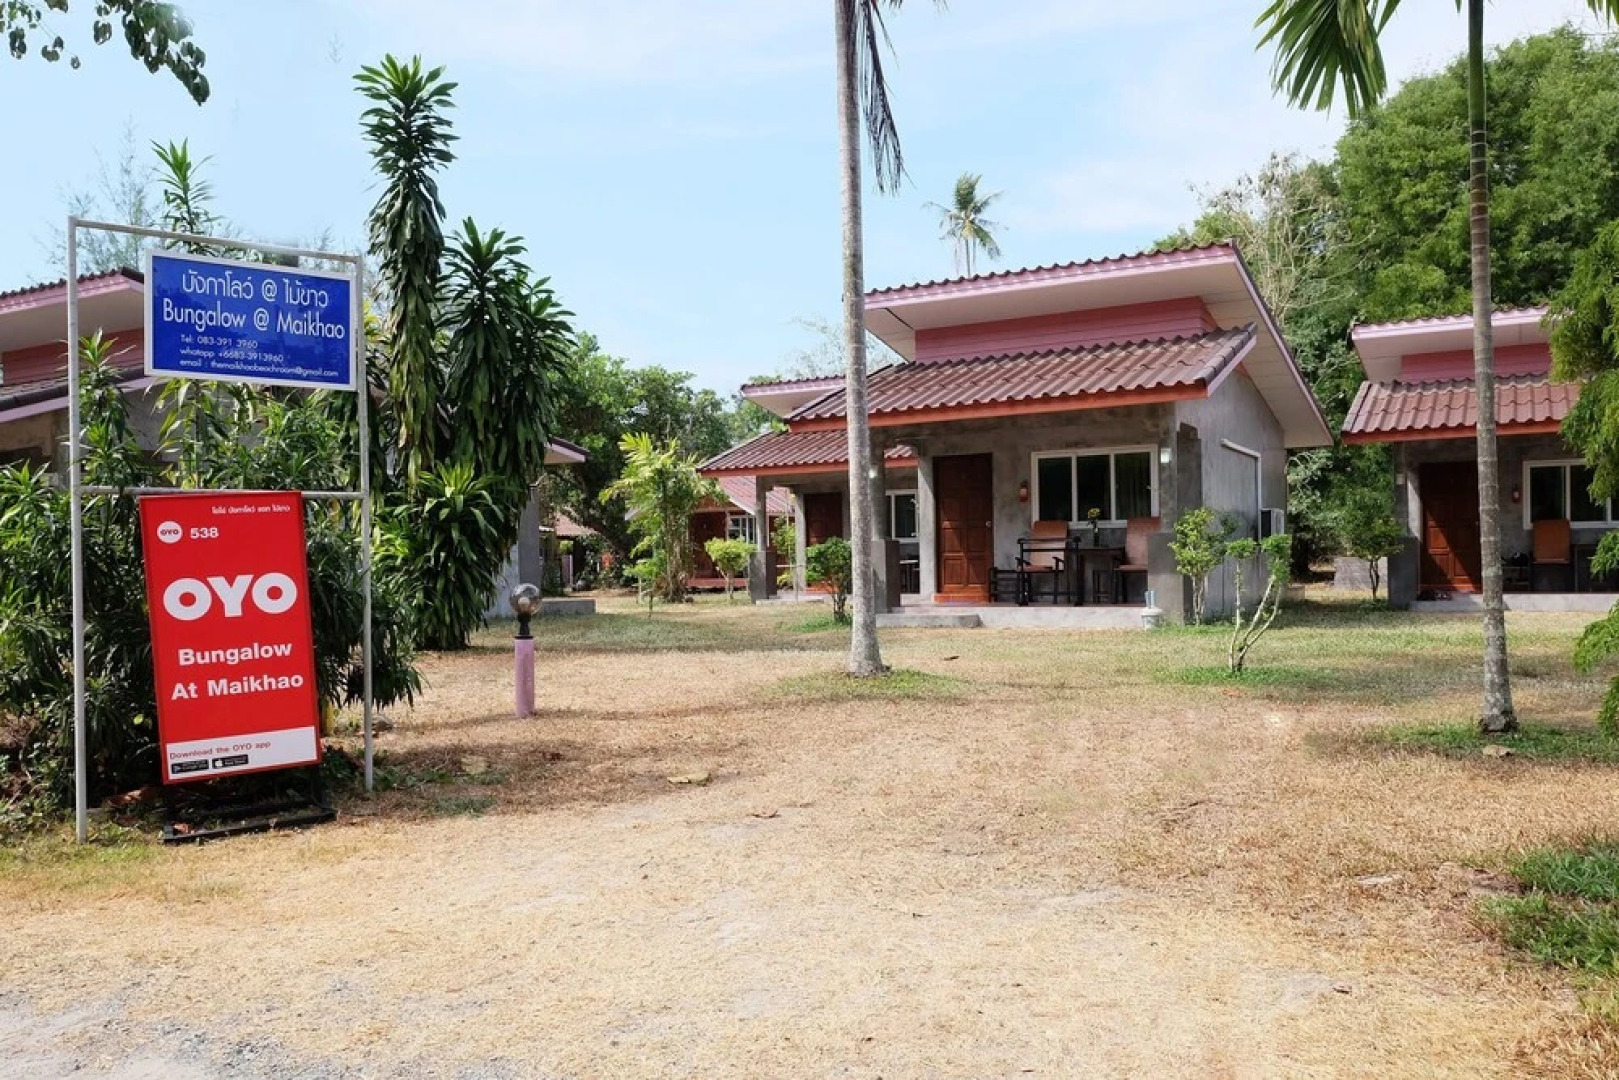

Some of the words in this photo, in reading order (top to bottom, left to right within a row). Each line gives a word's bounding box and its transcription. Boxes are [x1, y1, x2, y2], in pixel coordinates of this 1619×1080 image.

[261, 279, 278, 301] @
[283, 279, 329, 308] ไม้ขาว
[163, 298, 246, 332] Bungalow
[254, 308, 269, 331] @
[277, 311, 345, 339] Maikhao
[181, 334, 194, 343] Tel:
[197, 336, 232, 346] 083-391
[236, 339, 258, 349] 3960
[180, 359, 202, 367] email
[159, 528, 179, 536] OYO
[190, 527, 219, 539] 538
[163, 573, 298, 621] OYO
[178, 643, 292, 666] Bungalow
[171, 683, 198, 700] At
[207, 674, 304, 697] Maikhao
[170, 748, 213, 759] Download
[233, 743, 252, 751] OYO
[255, 741, 271, 749] app
